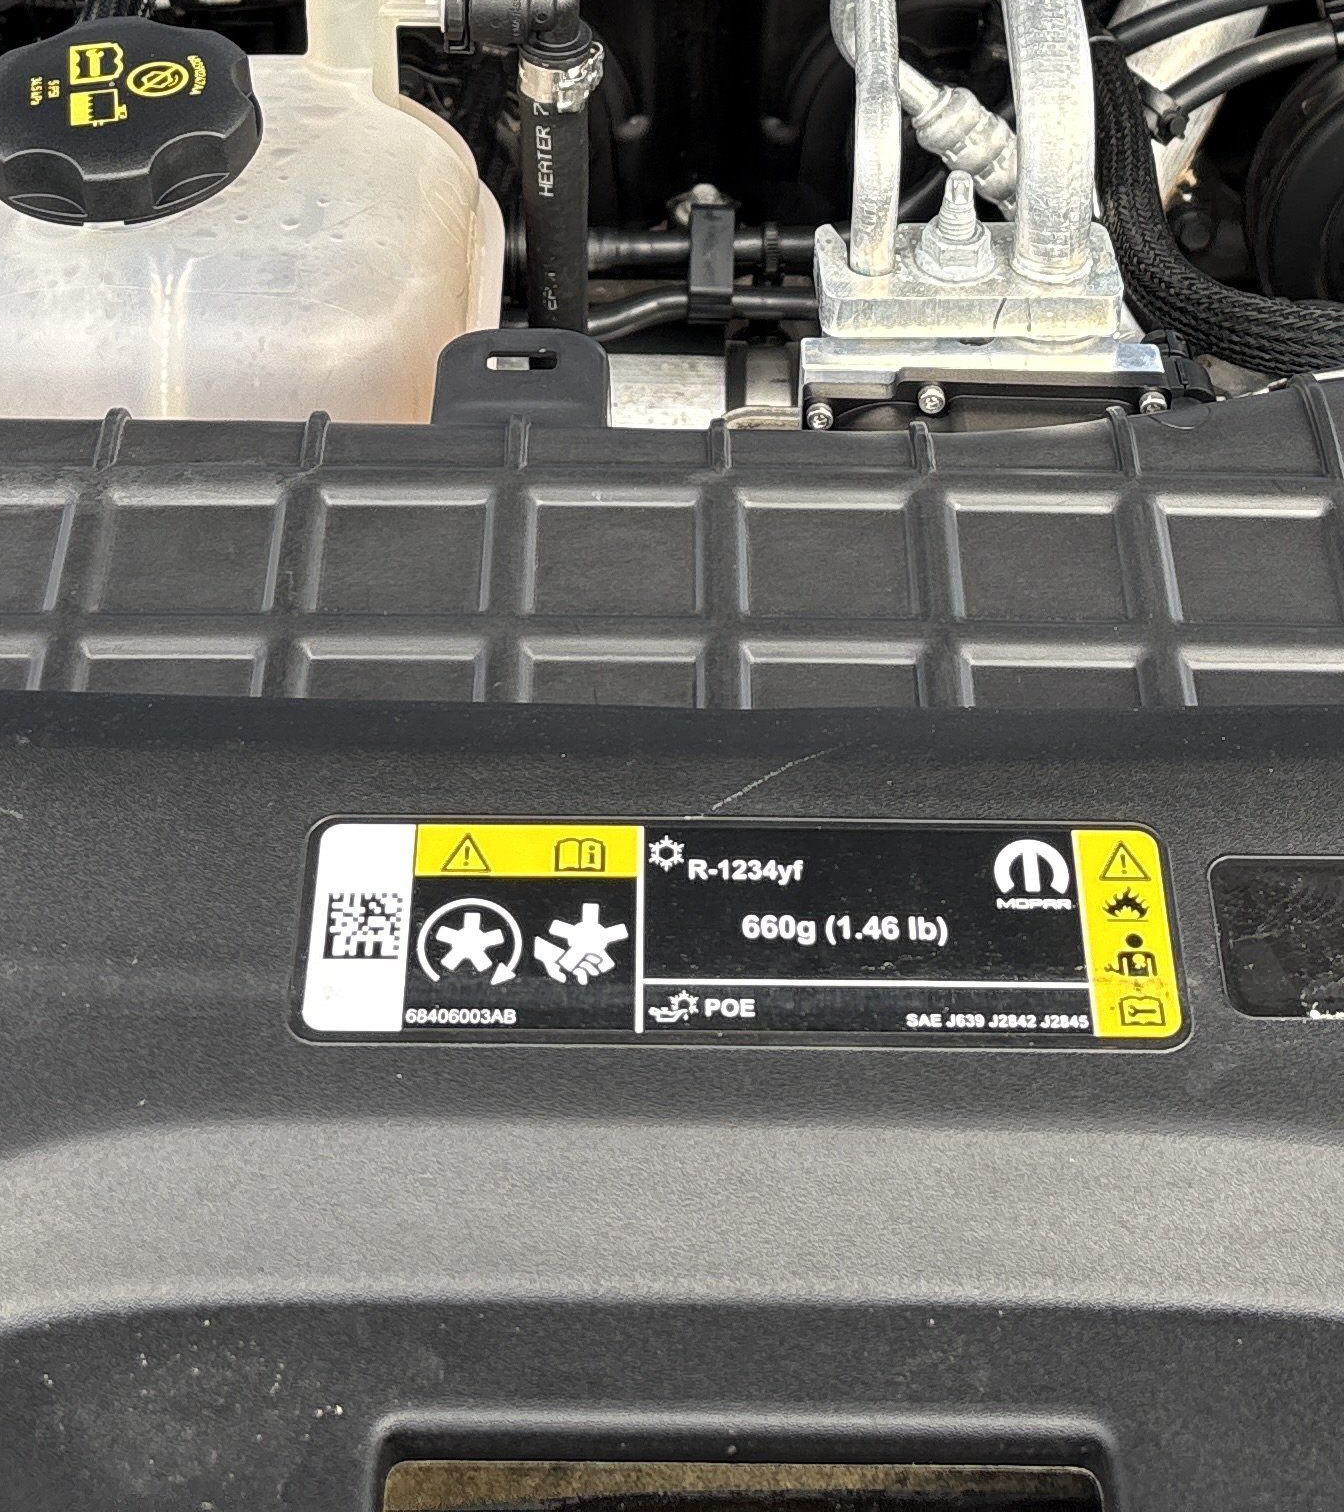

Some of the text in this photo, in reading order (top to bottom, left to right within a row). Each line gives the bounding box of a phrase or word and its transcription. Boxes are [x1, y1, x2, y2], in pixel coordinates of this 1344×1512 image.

[535, 125, 554, 197] HEATER
[687, 859, 805, 886] R-1234yf
[996, 897, 1072, 910] MOPAR
[741, 914, 949, 947] 660g (1.46 lb)
[405, 1008, 517, 1024] 68406003AB
[704, 998, 756, 1018] POE
[906, 1013, 1090, 1029] SAE J639 J2842 J2845
